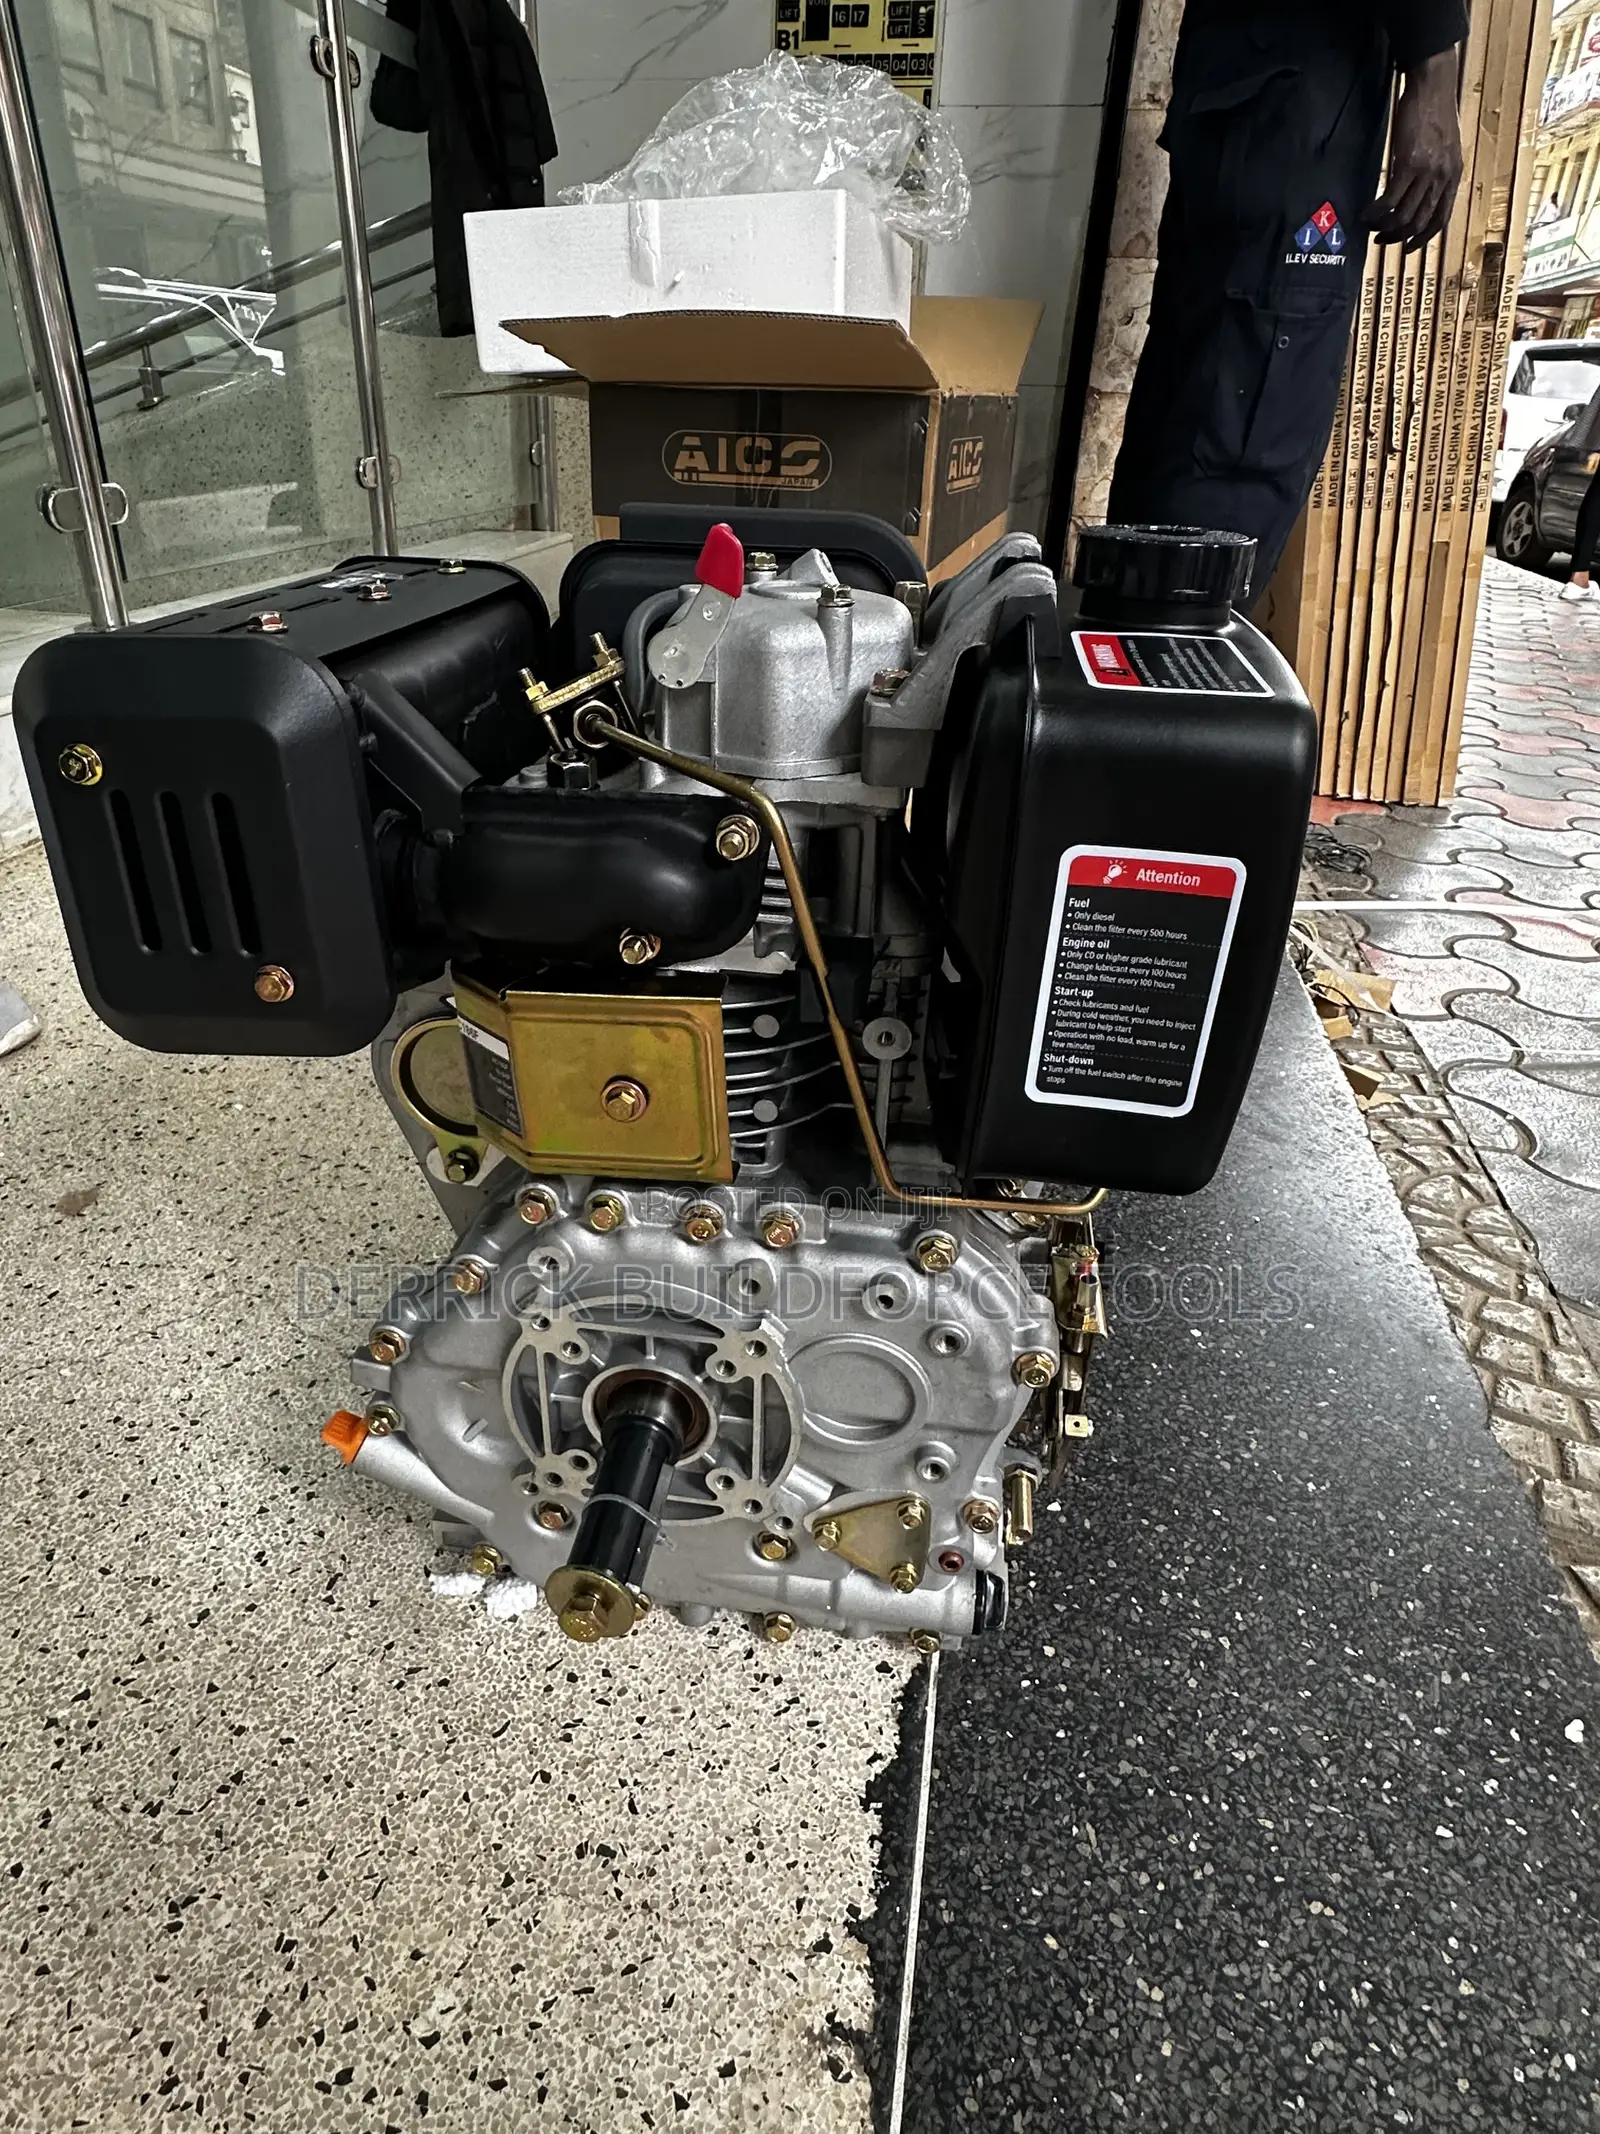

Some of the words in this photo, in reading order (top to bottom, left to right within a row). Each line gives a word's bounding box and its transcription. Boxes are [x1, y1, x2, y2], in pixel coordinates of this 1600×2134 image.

[780, 9, 798, 18] LIFT
[835, 11, 846, 22] 16
[854, 11, 865, 22] 17
[891, 6, 910, 16] LIFT
[778, 30, 799, 50] B1
[890, 25, 908, 35] LIFT
[875, 60, 889, 71] 05
[893, 60, 905, 71] 04
[911, 59, 925, 70] 03
[1319, 211, 1331, 226] K
[1304, 228, 1312, 245] I
[1332, 228, 1341, 245] L
[1309, 254, 1346, 266] SECURITY
[1364, 278, 1375, 314] MADE
[1383, 276, 1395, 313] MADE
[1402, 277, 1415, 314] MADE
[1423, 278, 1435, 315] MADE
[1501, 275, 1514, 312] MADE
[1361, 318, 1371, 330] IN
[1381, 316, 1391, 329] IN
[1420, 318, 1431, 330] IN
[1499, 317, 1510, 331] IN
[1357, 333, 1369, 372] CHINA
[1377, 332, 1389, 373] CHINA
[1397, 334, 1409, 373] CHINA
[1417, 334, 1429, 373] CHINA
[1437, 332, 1452, 386] 18V+10W
[1457, 331, 1472, 386] 18V+10W
[1476, 331, 1492, 386] 18V+10W
[1492, 332, 1506, 371] CHINA
[1355, 372, 1366, 404] 170W
[1373, 373, 1385, 404] 170W
[1394, 372, 1404, 403] 170W
[1414, 372, 1424, 405] 170W
[1490, 374, 1501, 406] 170W
[1433, 390, 1445, 421] 170W
[1453, 389, 1465, 420] 170W
[1472, 389, 1485, 420] 170W
[1333, 420, 1343, 459] CHINA
[1350, 408, 1363, 460] 18V+10W
[1409, 410, 1422, 462] 18V+10W
[1428, 423, 1441, 461] CHINA
[1448, 423, 1461, 461] CHINA
[1467, 423, 1480, 461] CHINA
[1483, 410, 1496, 462] 18V+10W
[1331, 461, 1340, 472] IN
[1426, 464, 1436, 475] IN
[1445, 464, 1456, 475] IN
[1464, 464, 1474, 475] IN
[780, 477, 814, 487] JAPAN
[1312, 476, 1324, 509] MADE
[1328, 474, 1340, 507] MADE
[1422, 478, 1435, 512] MADE
[1442, 478, 1455, 512] MADE
[1459, 478, 1473, 512] MADE
[1136, 868, 1201, 887] Attention
[1069, 898, 1090, 908] Fuel
[1074, 911, 1091, 921] Only
[1092, 912, 1115, 921] diesel
[1072, 923, 1093, 931] Clean
[1095, 924, 1107, 932] the
[1108, 925, 1125, 934] filter
[1127, 928, 1149, 937] every
[1150, 929, 1164, 937] 500
[1165, 930, 1188, 940] hours
[1062, 937, 1096, 949] Engine
[1097, 940, 1110, 948] oil
[1066, 962, 1094, 971] Change
[1095, 963, 1128, 973] lubricant
[1129, 967, 1150, 976] every
[1152, 969, 1164, 977] 100
[1165, 970, 1187, 979] hours
[1106, 953, 1129, 963] higher
[1154, 956, 1188, 968] lubricant
[1064, 972, 1084, 980] Clean
[1086, 973, 1098, 981] the
[1100, 974, 1116, 983] filter
[1118, 977, 1139, 986] every
[1140, 979, 1152, 987] 100
[1153, 980, 1175, 989] hours
[1054, 986, 1094, 999] Start-up
[1059, 999, 1080, 1007] Check
[1082, 1000, 1118, 1010] lubricants
[1120, 1003, 1134, 1012] and
[1135, 1005, 1150, 1014] fuel
[1055, 1020, 1087, 1029] lubricant
[1088, 1022, 1096, 1030] to
[1097, 1022, 1113, 1031] help
[1114, 1025, 1132, 1033] start
[1057, 1009, 1081, 1019] During
[1082, 1011, 1098, 1019] cold
[1131, 1016, 1145, 1024] you
[1146, 1018, 1165, 1026] need
[1166, 1020, 1174, 1028] to
[1175, 1021, 1196, 1031] inject
[1052, 1040, 1065, 1048] few
[1066, 1042, 1095, 1050] minutes
[1054, 1030, 1088, 1039] Operation
[1089, 1033, 1105, 1041] with
[1136, 1039, 1157, 1047] warm
[1158, 1041, 1167, 1049] up
[1169, 1042, 1179, 1050] for
[1044, 1053, 1094, 1065] Shut-down
[1047, 1075, 1066, 1084] stops
[1048, 1065, 1063, 1073] Turn
[1064, 1066, 1074, 1074] off
[1074, 1067, 1086, 1075] the
[1087, 1068, 1101, 1076] fuel
[1102, 1070, 1126, 1080] switch
[1127, 1073, 1143, 1082] after
[1144, 1075, 1156, 1083] the
[1158, 1077, 1182, 1087] engine
